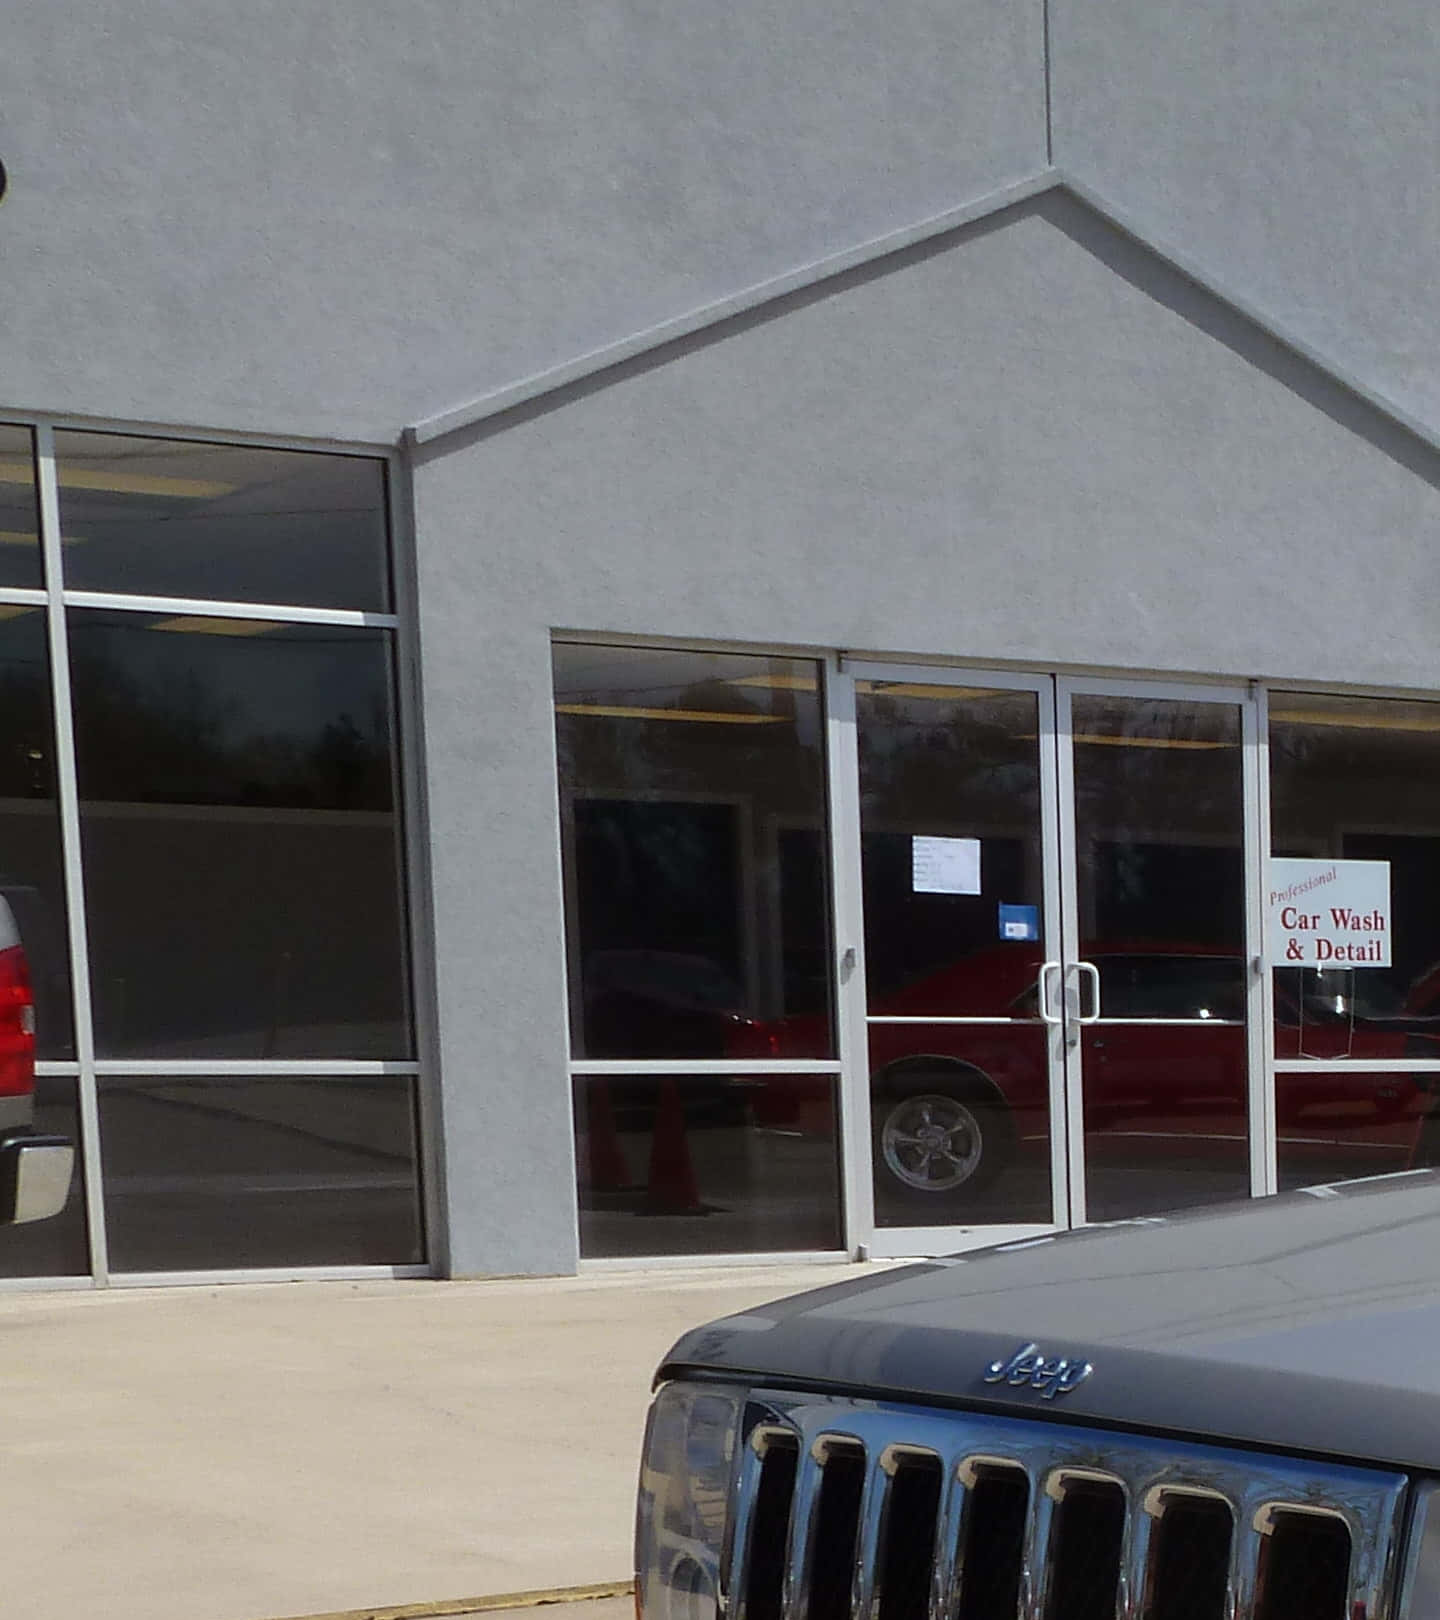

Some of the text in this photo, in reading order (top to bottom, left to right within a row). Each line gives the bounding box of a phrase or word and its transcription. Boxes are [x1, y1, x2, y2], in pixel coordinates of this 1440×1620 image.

[1270, 866, 1337, 906] Professional
[1281, 907, 1385, 931] Car Wash
[1286, 938, 1382, 961] & Detail
[984, 1343, 1092, 1399] Jeep
